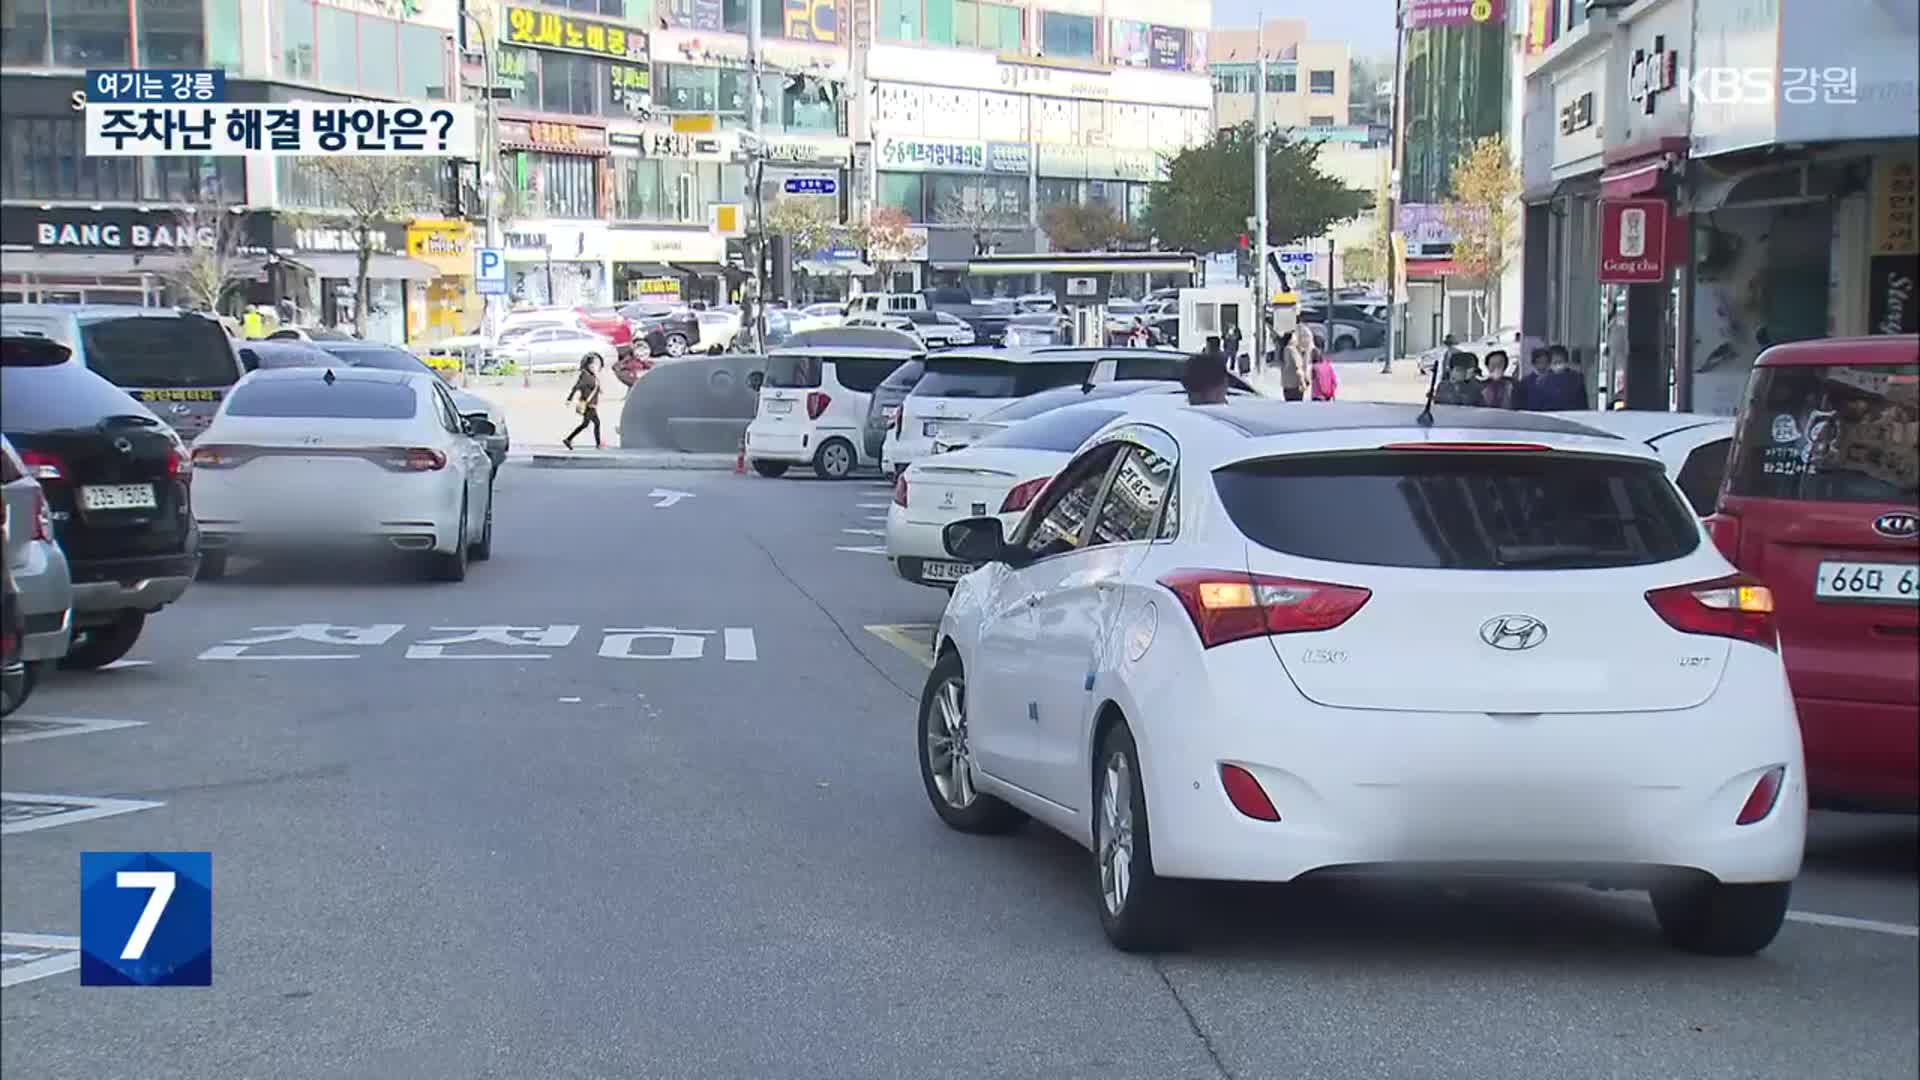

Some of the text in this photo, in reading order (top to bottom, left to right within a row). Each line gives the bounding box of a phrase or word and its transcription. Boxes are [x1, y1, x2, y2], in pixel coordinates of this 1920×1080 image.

[37, 223, 215, 248] BANG BANG
[481, 252, 499, 277] P
[1604, 259, 1659, 274] Gong cha
[1880, 518, 1915, 531] KIA
[1898, 569, 1919, 595] 6
